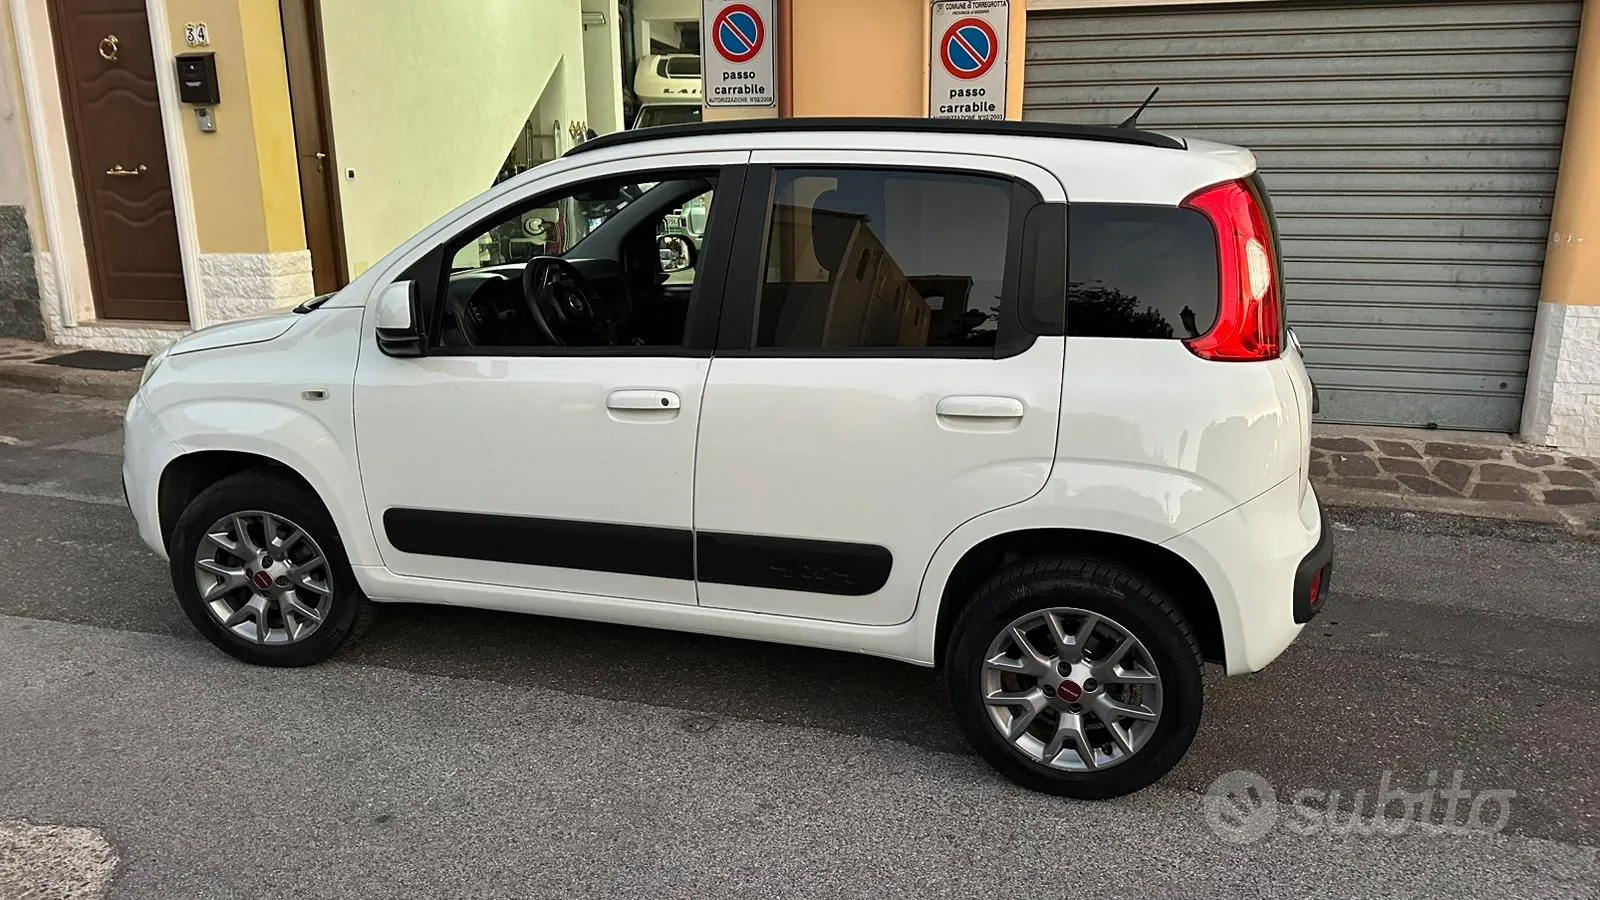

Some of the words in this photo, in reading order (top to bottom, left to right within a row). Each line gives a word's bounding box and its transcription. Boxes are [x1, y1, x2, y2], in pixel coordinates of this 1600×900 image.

[945, 2, 966, 10] COMUNE
[972, 0, 1007, 9] TORREGROTTA
[186, 27, 205, 41] 34
[722, 71, 756, 81] passo
[714, 84, 765, 94] carrabile
[949, 88, 986, 99] passo
[939, 101, 996, 113] carrabile
